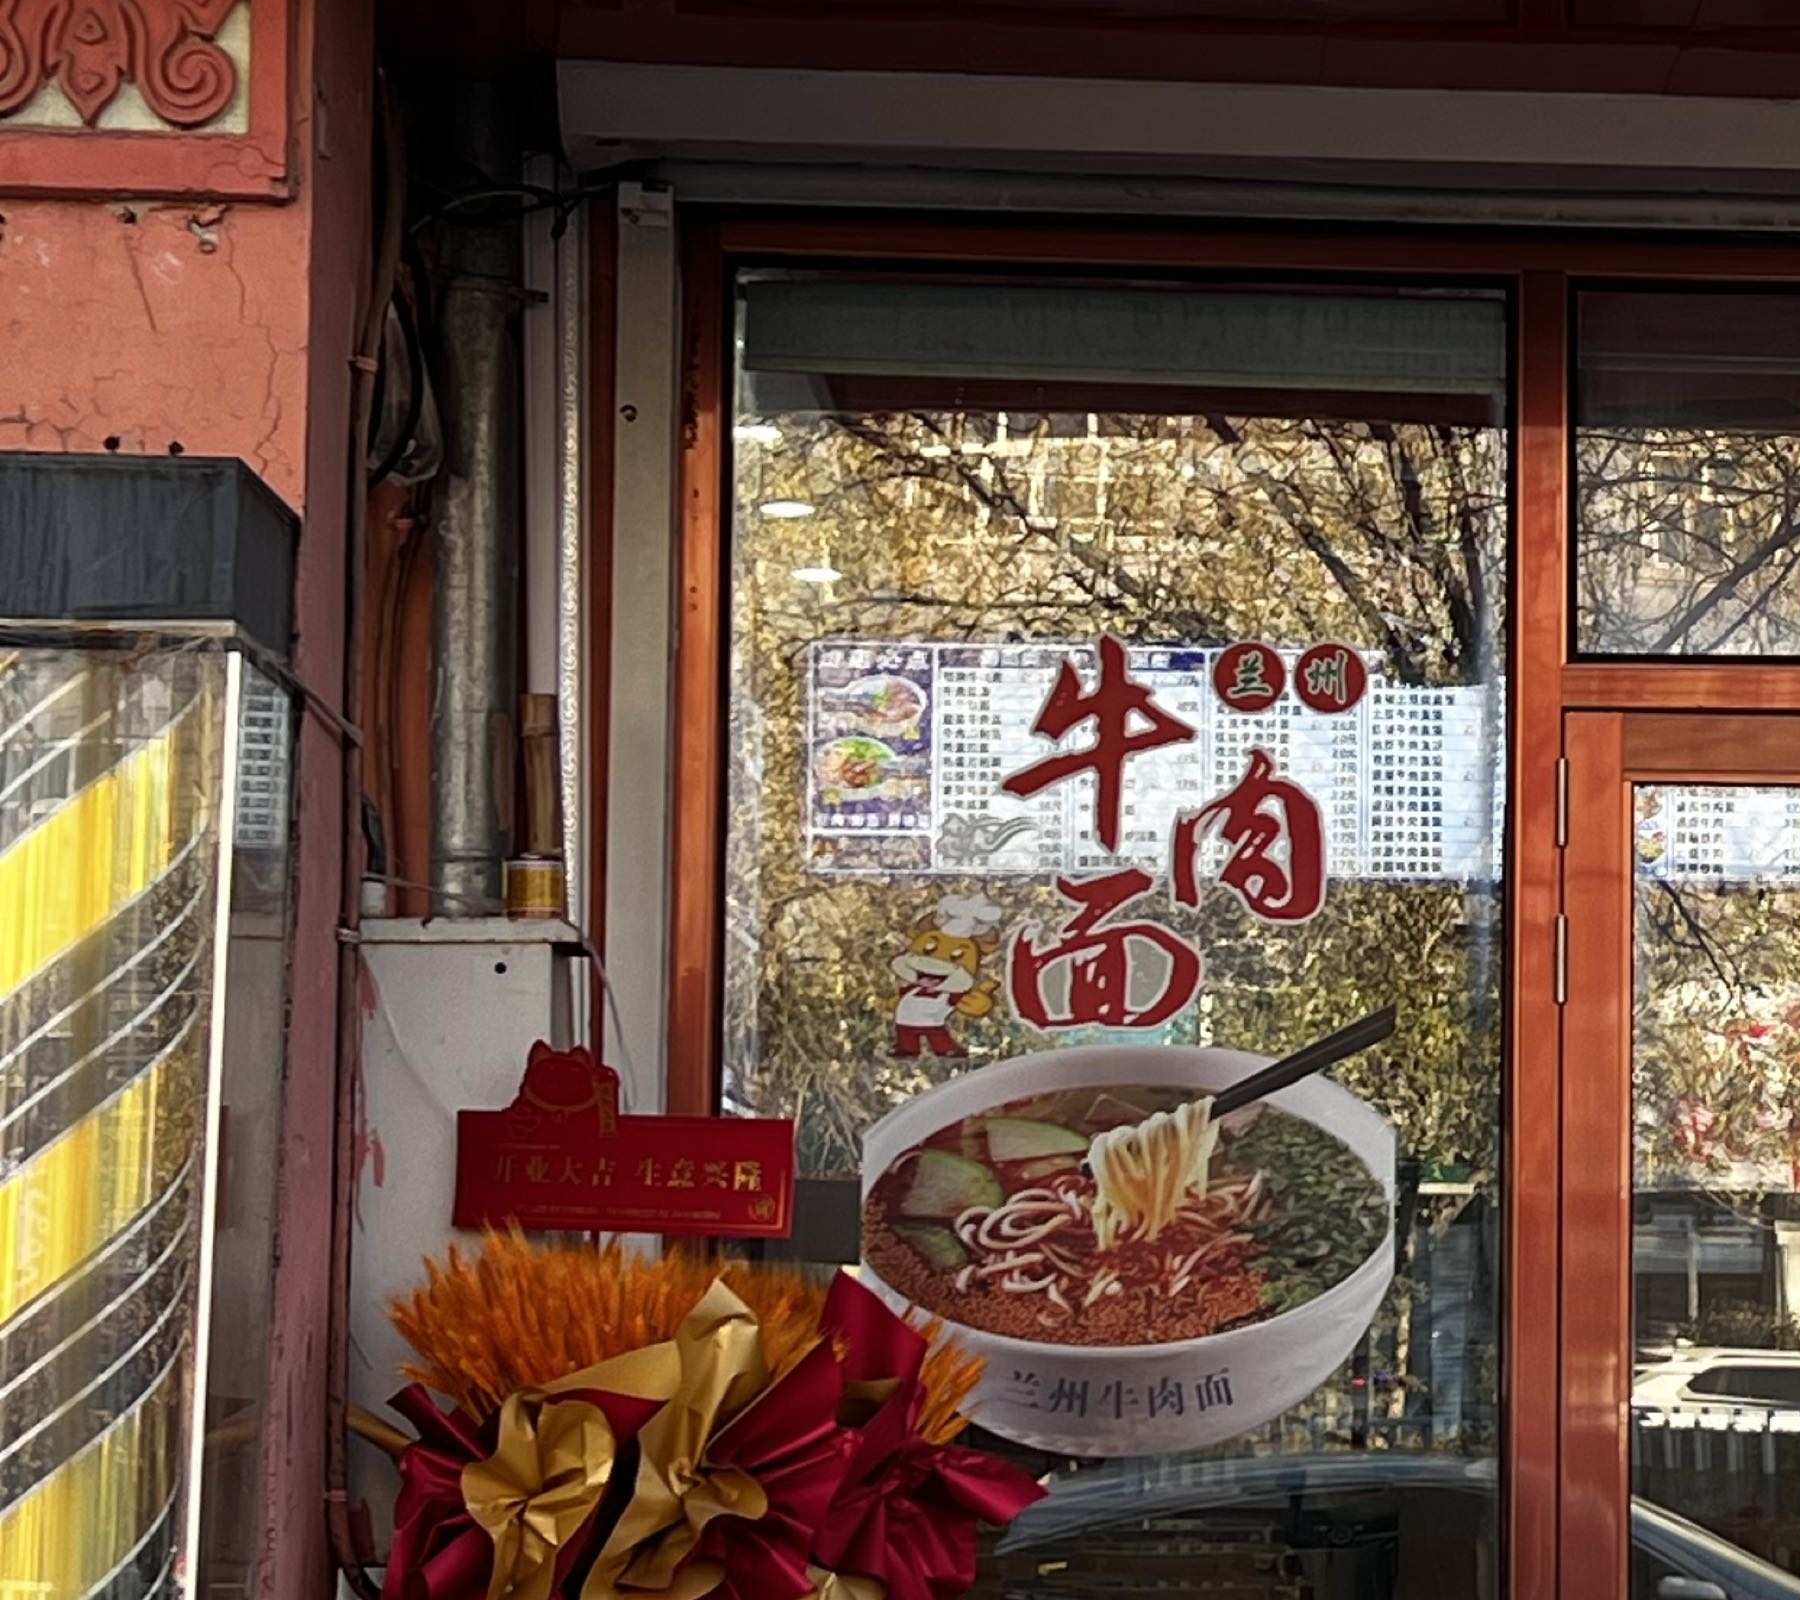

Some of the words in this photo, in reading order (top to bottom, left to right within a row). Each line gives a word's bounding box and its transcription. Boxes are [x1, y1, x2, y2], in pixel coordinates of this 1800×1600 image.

[1225, 649, 1350, 706] 兰州
[1005, 1366, 1235, 1421] 兰州牛肉面
